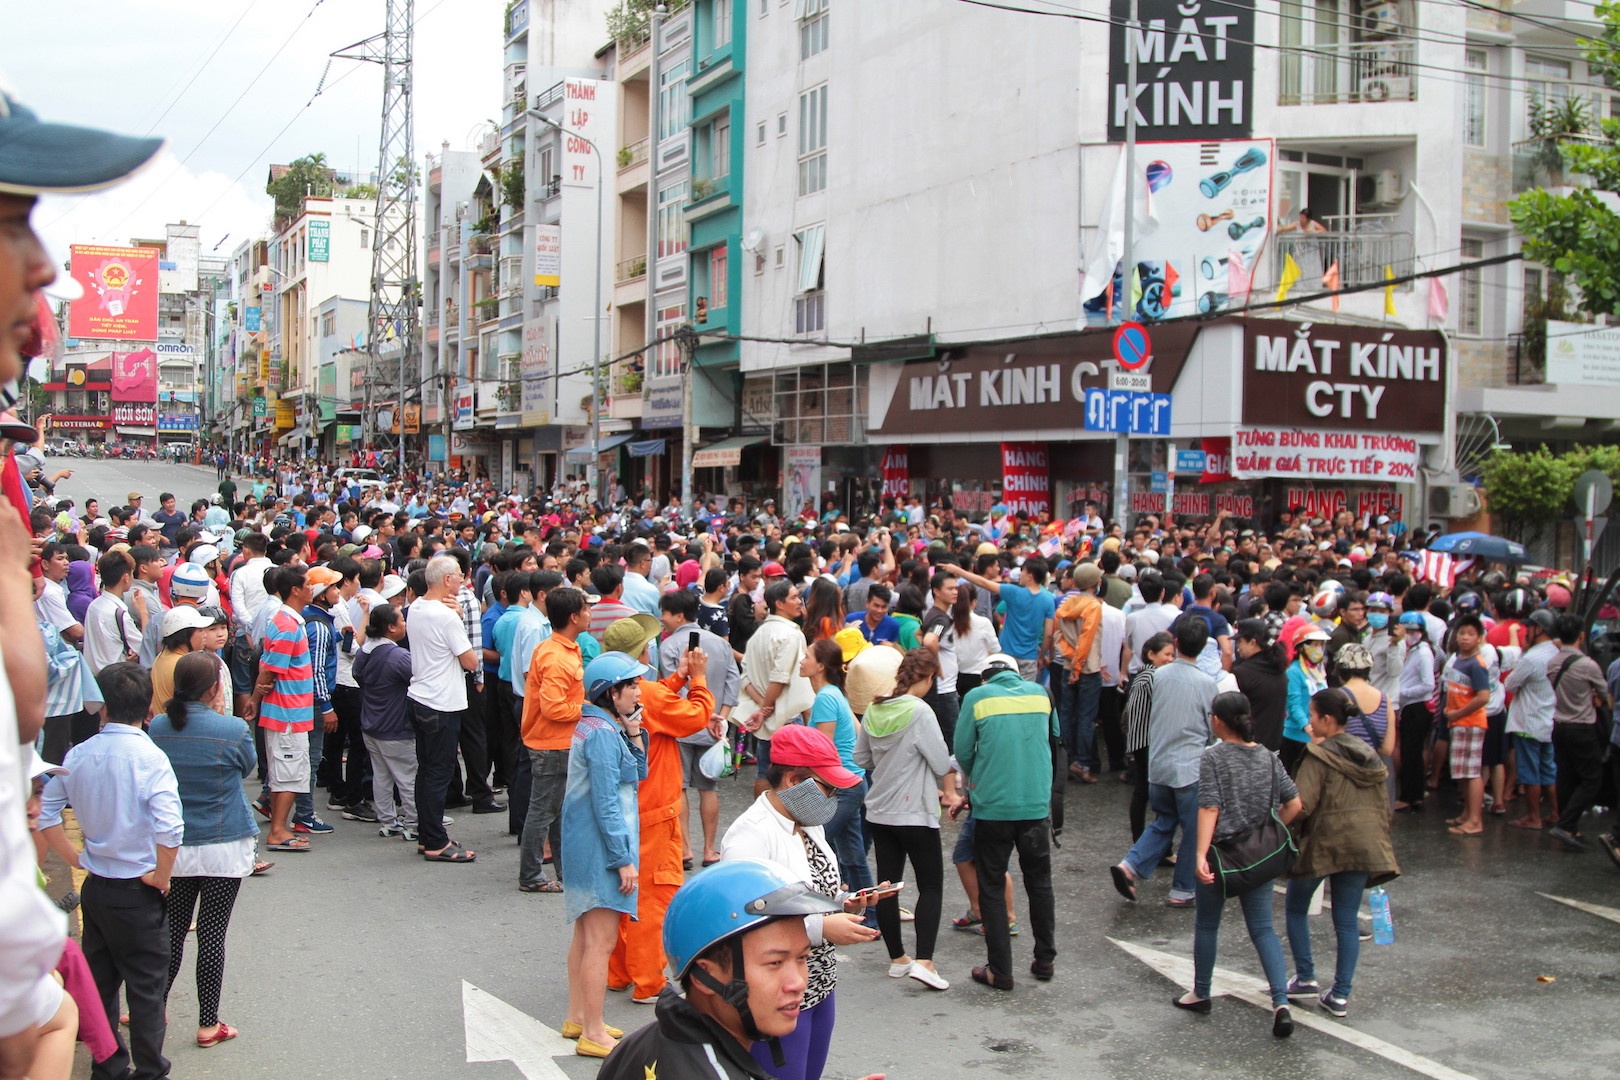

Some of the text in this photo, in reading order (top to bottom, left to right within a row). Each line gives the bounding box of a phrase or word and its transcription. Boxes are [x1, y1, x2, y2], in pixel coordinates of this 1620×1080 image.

[1125, 0, 1238, 63] MẮT
[1115, 67, 1243, 127] KÍNH
[573, 165, 585, 180] TY
[1256, 322, 1439, 381] MẮT KÍNH
[910, 352, 972, 410] MẮT
[980, 354, 1061, 406] KÍNH
[115, 405, 134, 421] NÓN
[135, 405, 153, 422] SƠN
[1305, 380, 1385, 420] CTY
[1280, 427, 1321, 448] BỪNG
[1325, 433, 1358, 450] KHAI
[1005, 445, 1046, 467] HÀNG
[1236, 451, 1415, 478] GIẢM GIÁ TRỰC TIẾP 20%
[1004, 472, 1049, 492] CHÍNH
[1132, 486, 1165, 513] HÀNG
[1173, 488, 1210, 515] CHÍNH
[1216, 489, 1253, 519] HÃNG
